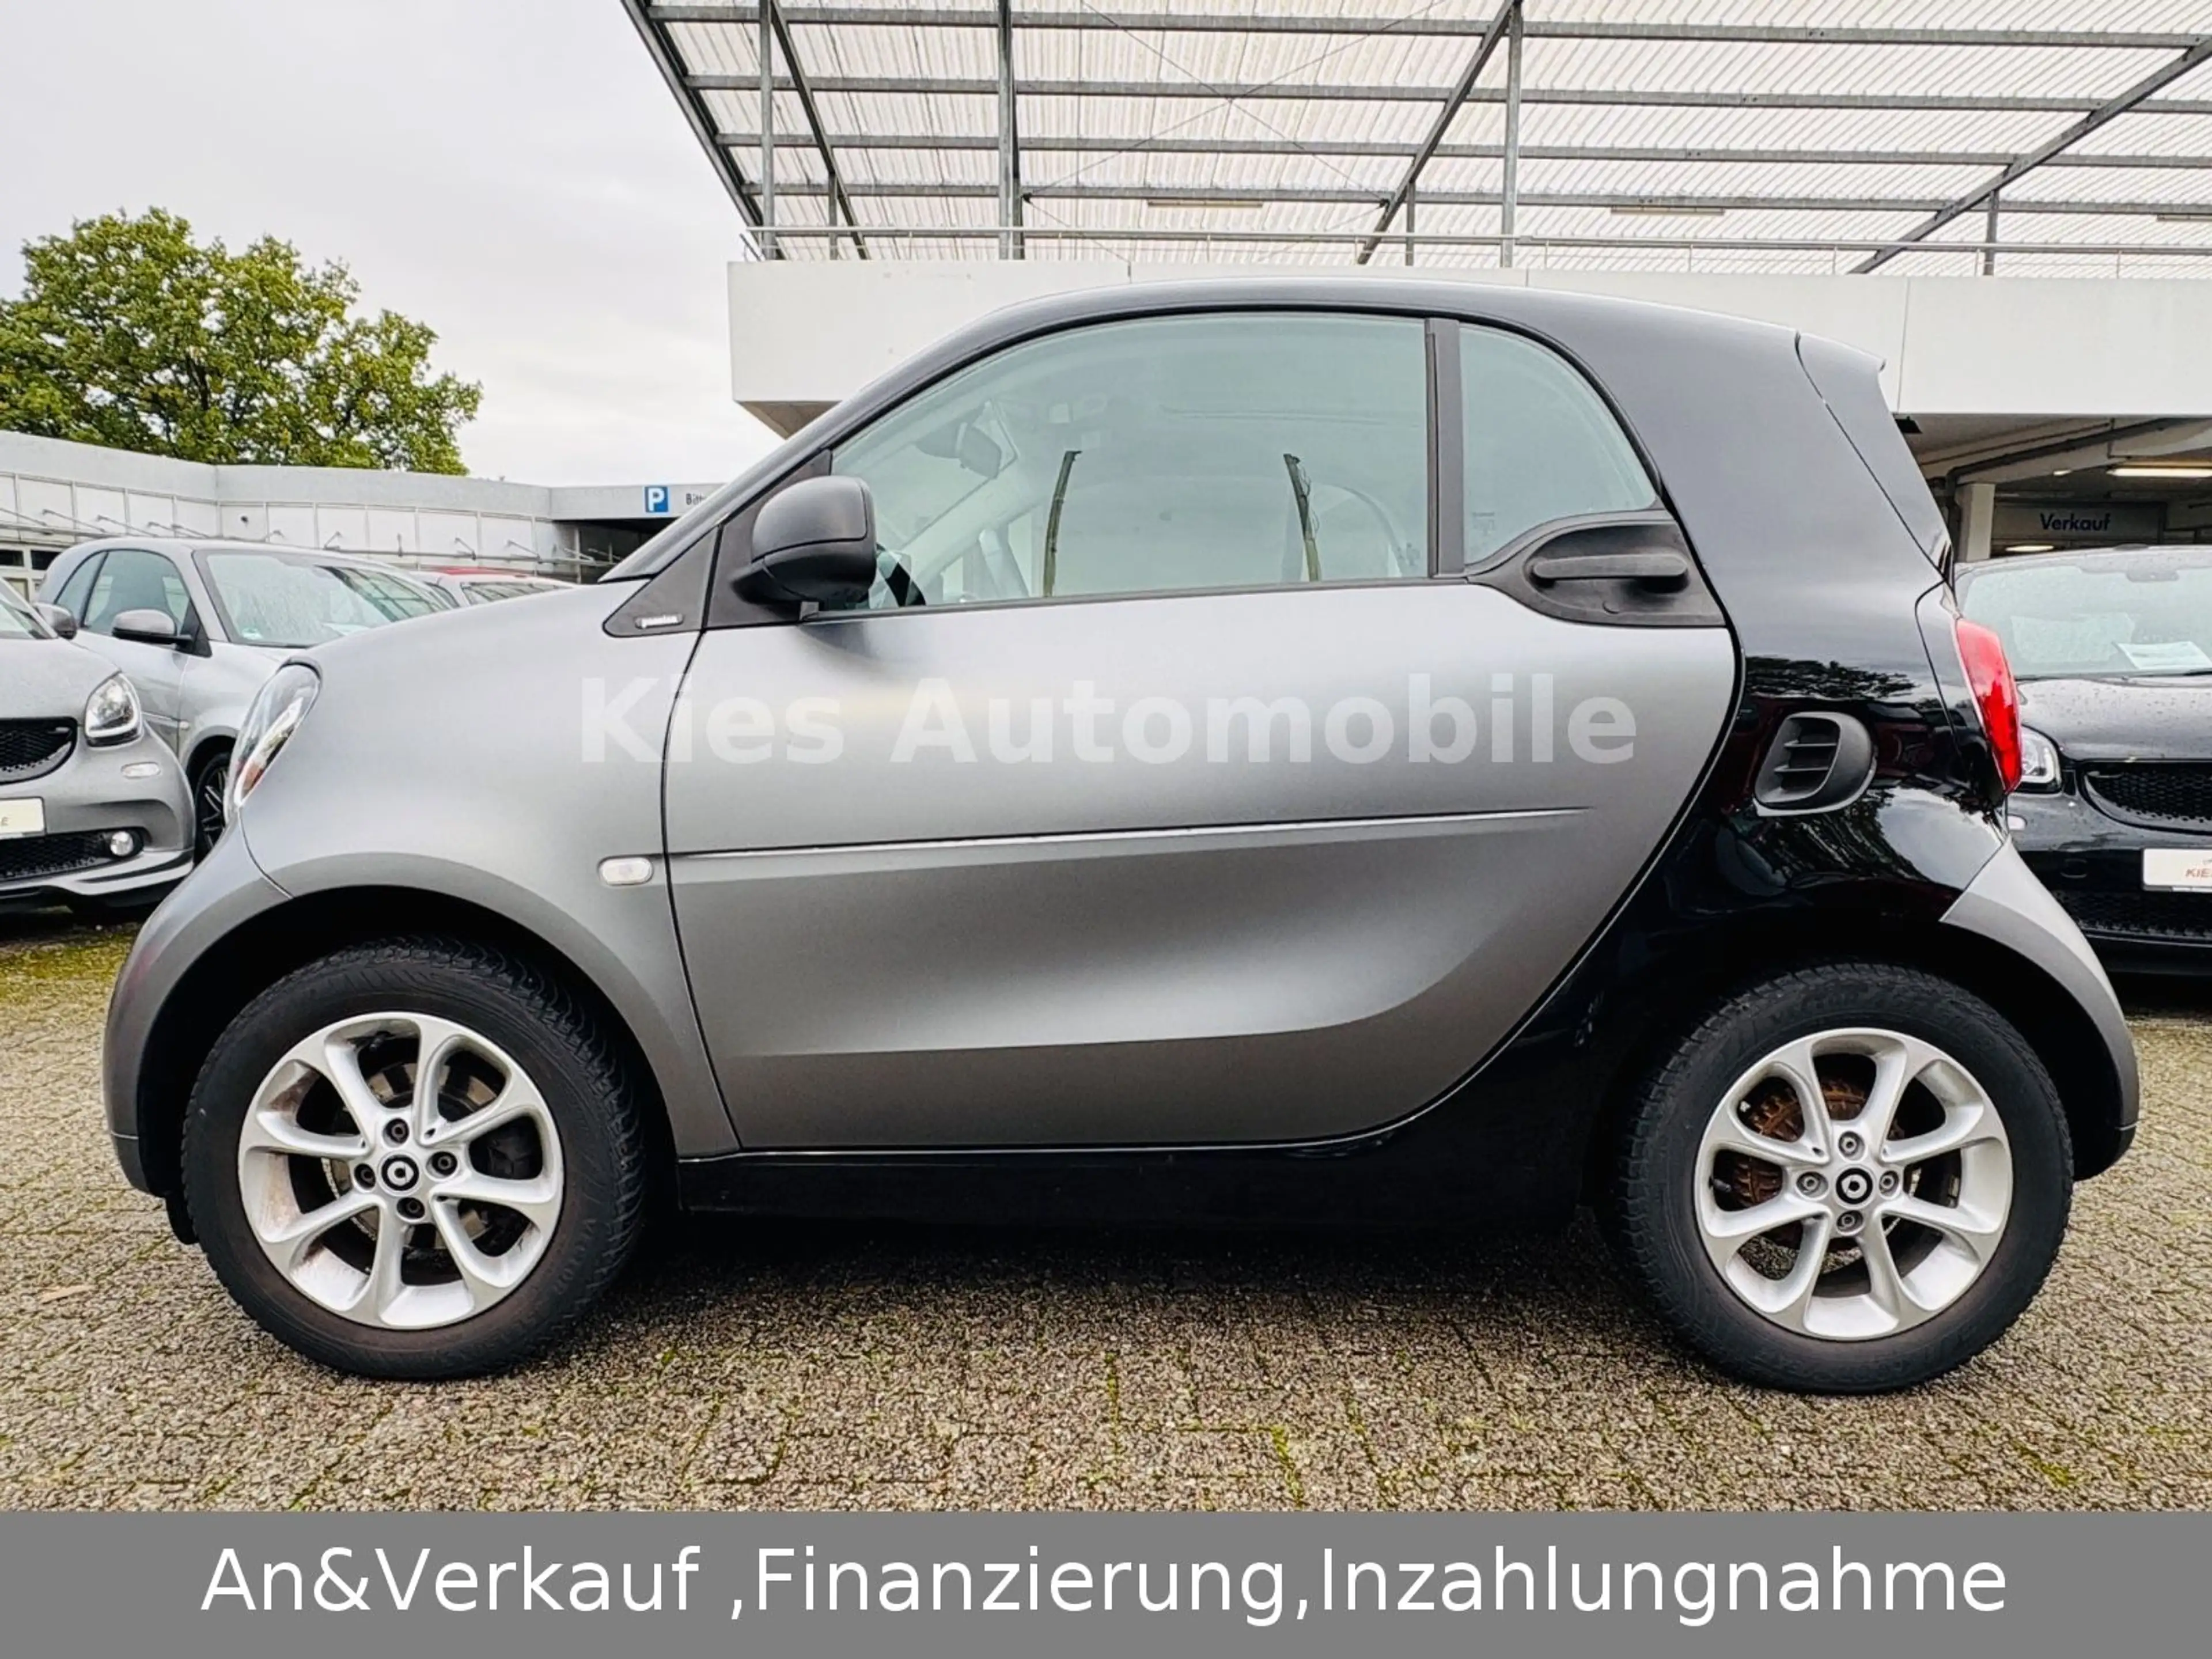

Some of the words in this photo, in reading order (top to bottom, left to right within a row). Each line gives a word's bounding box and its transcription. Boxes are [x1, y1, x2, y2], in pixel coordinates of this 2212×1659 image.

[648, 488, 665, 511] P
[2040, 513, 2111, 531] Verkauf
[2186, 868, 2212, 878] KIE
